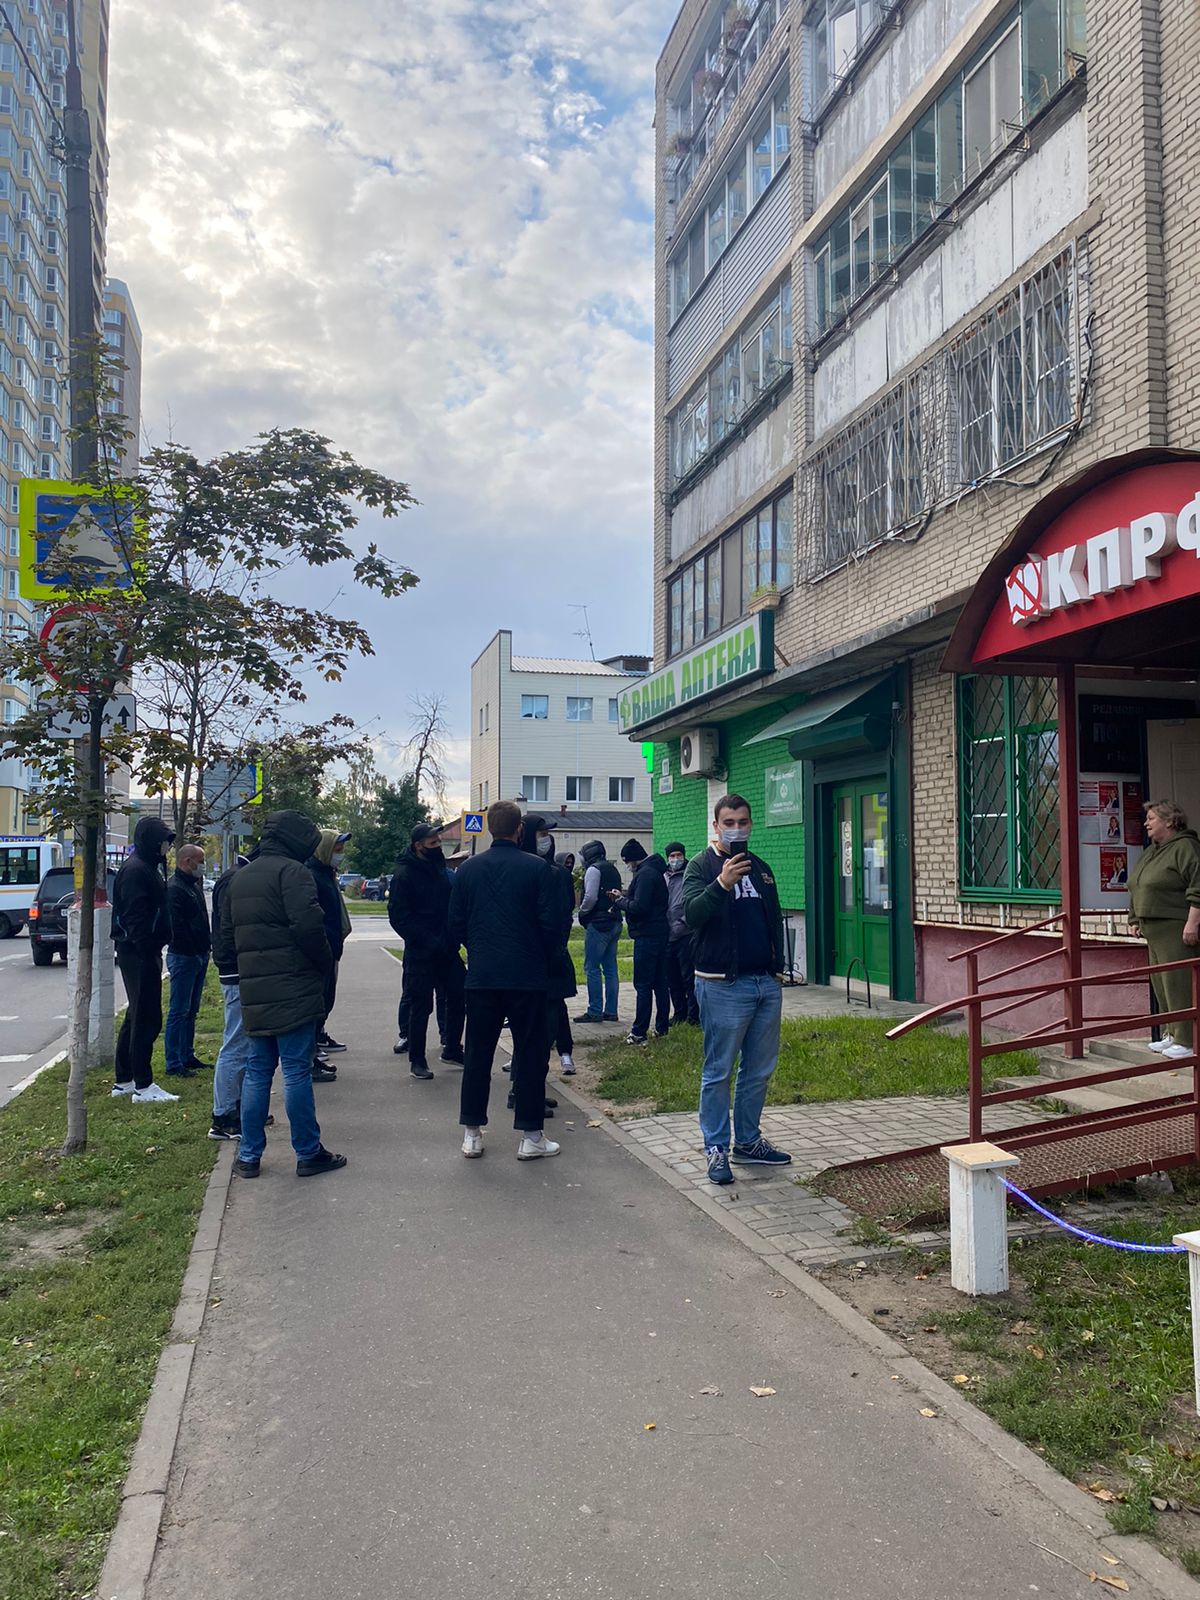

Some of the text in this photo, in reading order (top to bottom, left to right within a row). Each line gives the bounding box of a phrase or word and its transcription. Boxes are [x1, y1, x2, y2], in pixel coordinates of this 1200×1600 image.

[1047, 491, 1200, 611] КПРФ
[631, 624, 757, 725] ВАША АПТЕКА
